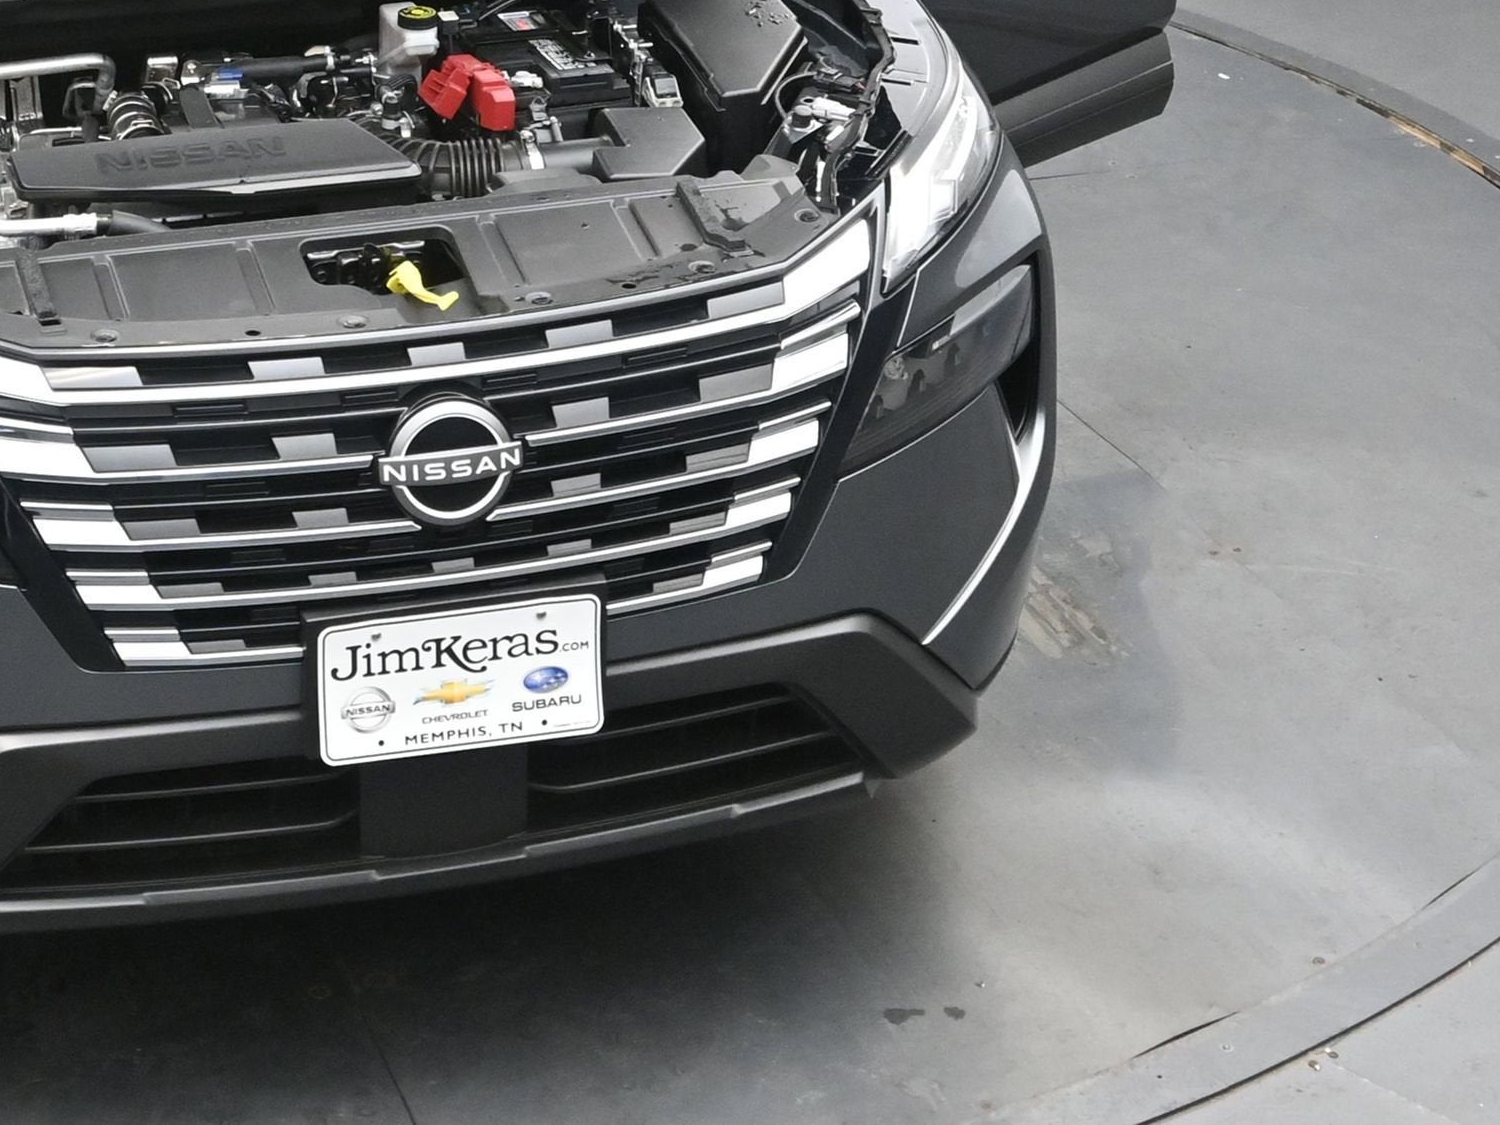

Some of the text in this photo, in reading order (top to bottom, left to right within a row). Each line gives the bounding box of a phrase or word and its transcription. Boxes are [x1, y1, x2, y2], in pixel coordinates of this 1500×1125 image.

[94, 136, 286, 173] NISSAN
[382, 448, 521, 482] NISSAN
[345, 703, 391, 716] NISSAN
[511, 694, 583, 712] SUBARU
[421, 709, 489, 725] CHEVROLET
[404, 721, 524, 746] MEMPHIS, TN
